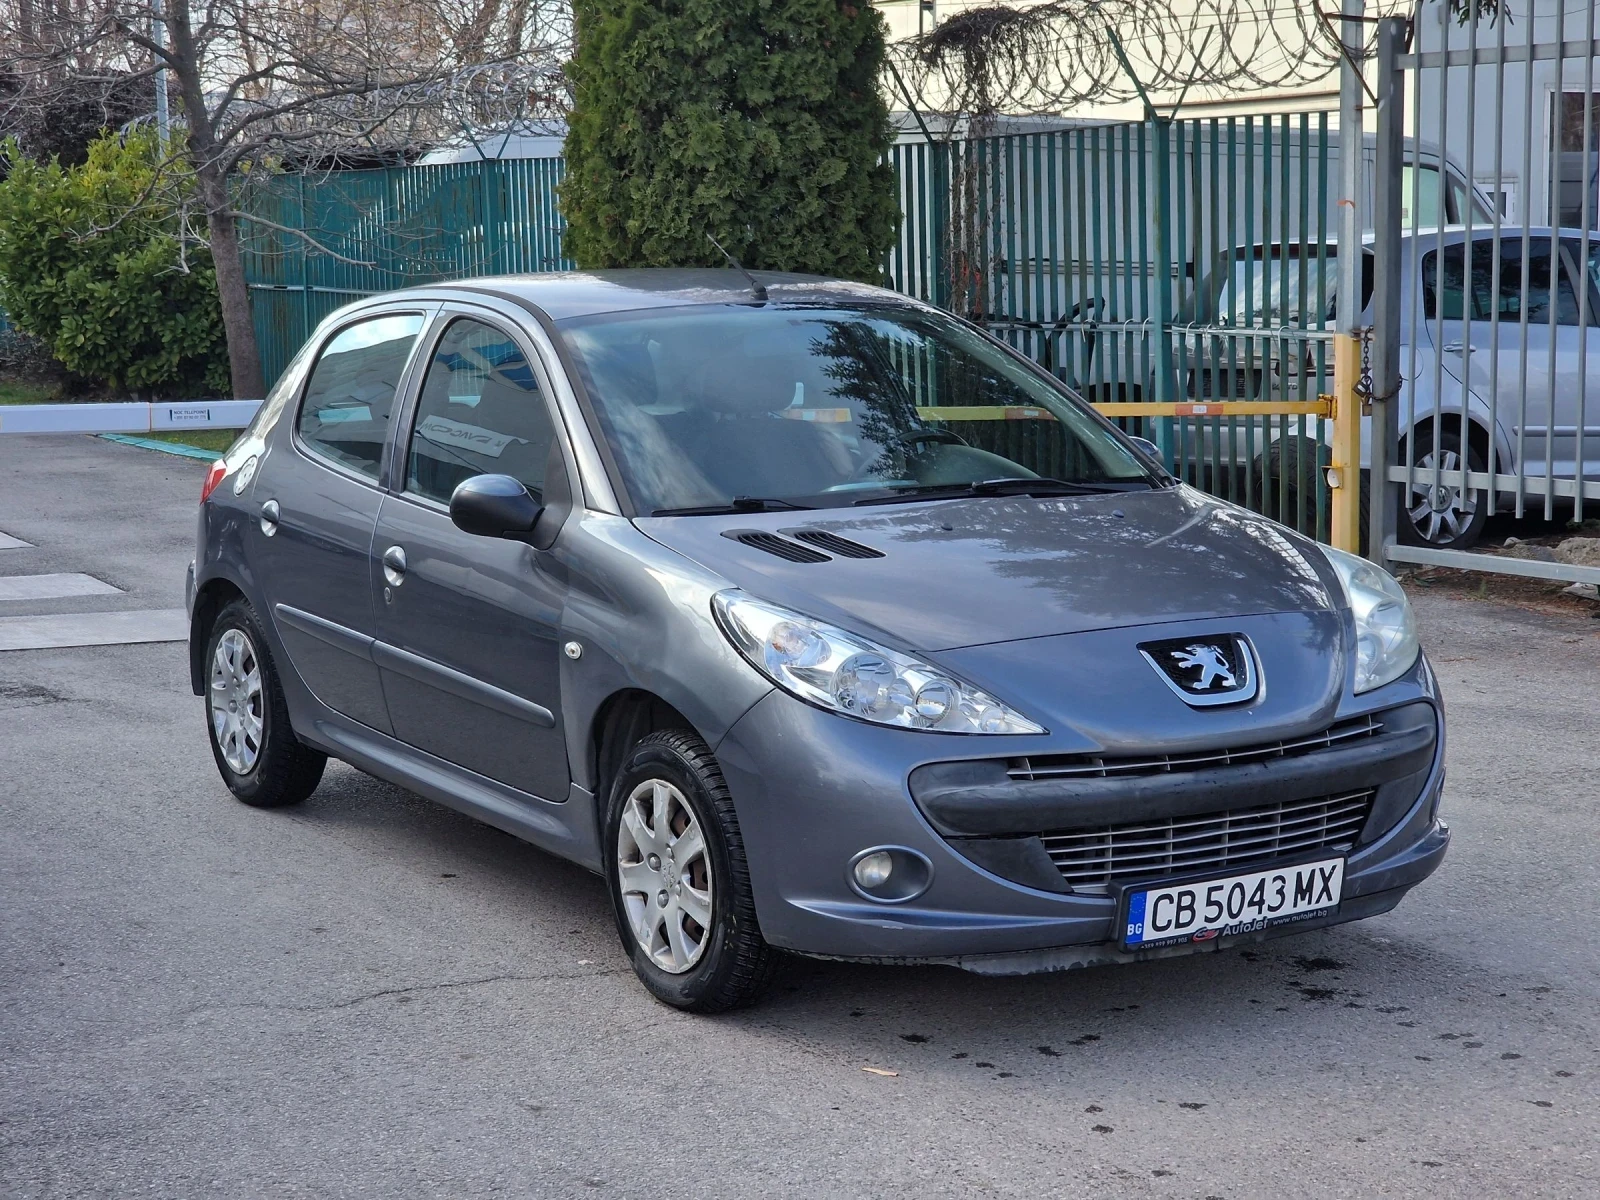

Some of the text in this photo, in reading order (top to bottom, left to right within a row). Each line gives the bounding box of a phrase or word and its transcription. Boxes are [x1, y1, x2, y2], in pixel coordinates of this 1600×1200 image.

[1127, 864, 1338, 936] BG CB 5043 MX
[1272, 909, 1328, 926] www.autojet.bg
[1222, 919, 1269, 937] AutoJet
